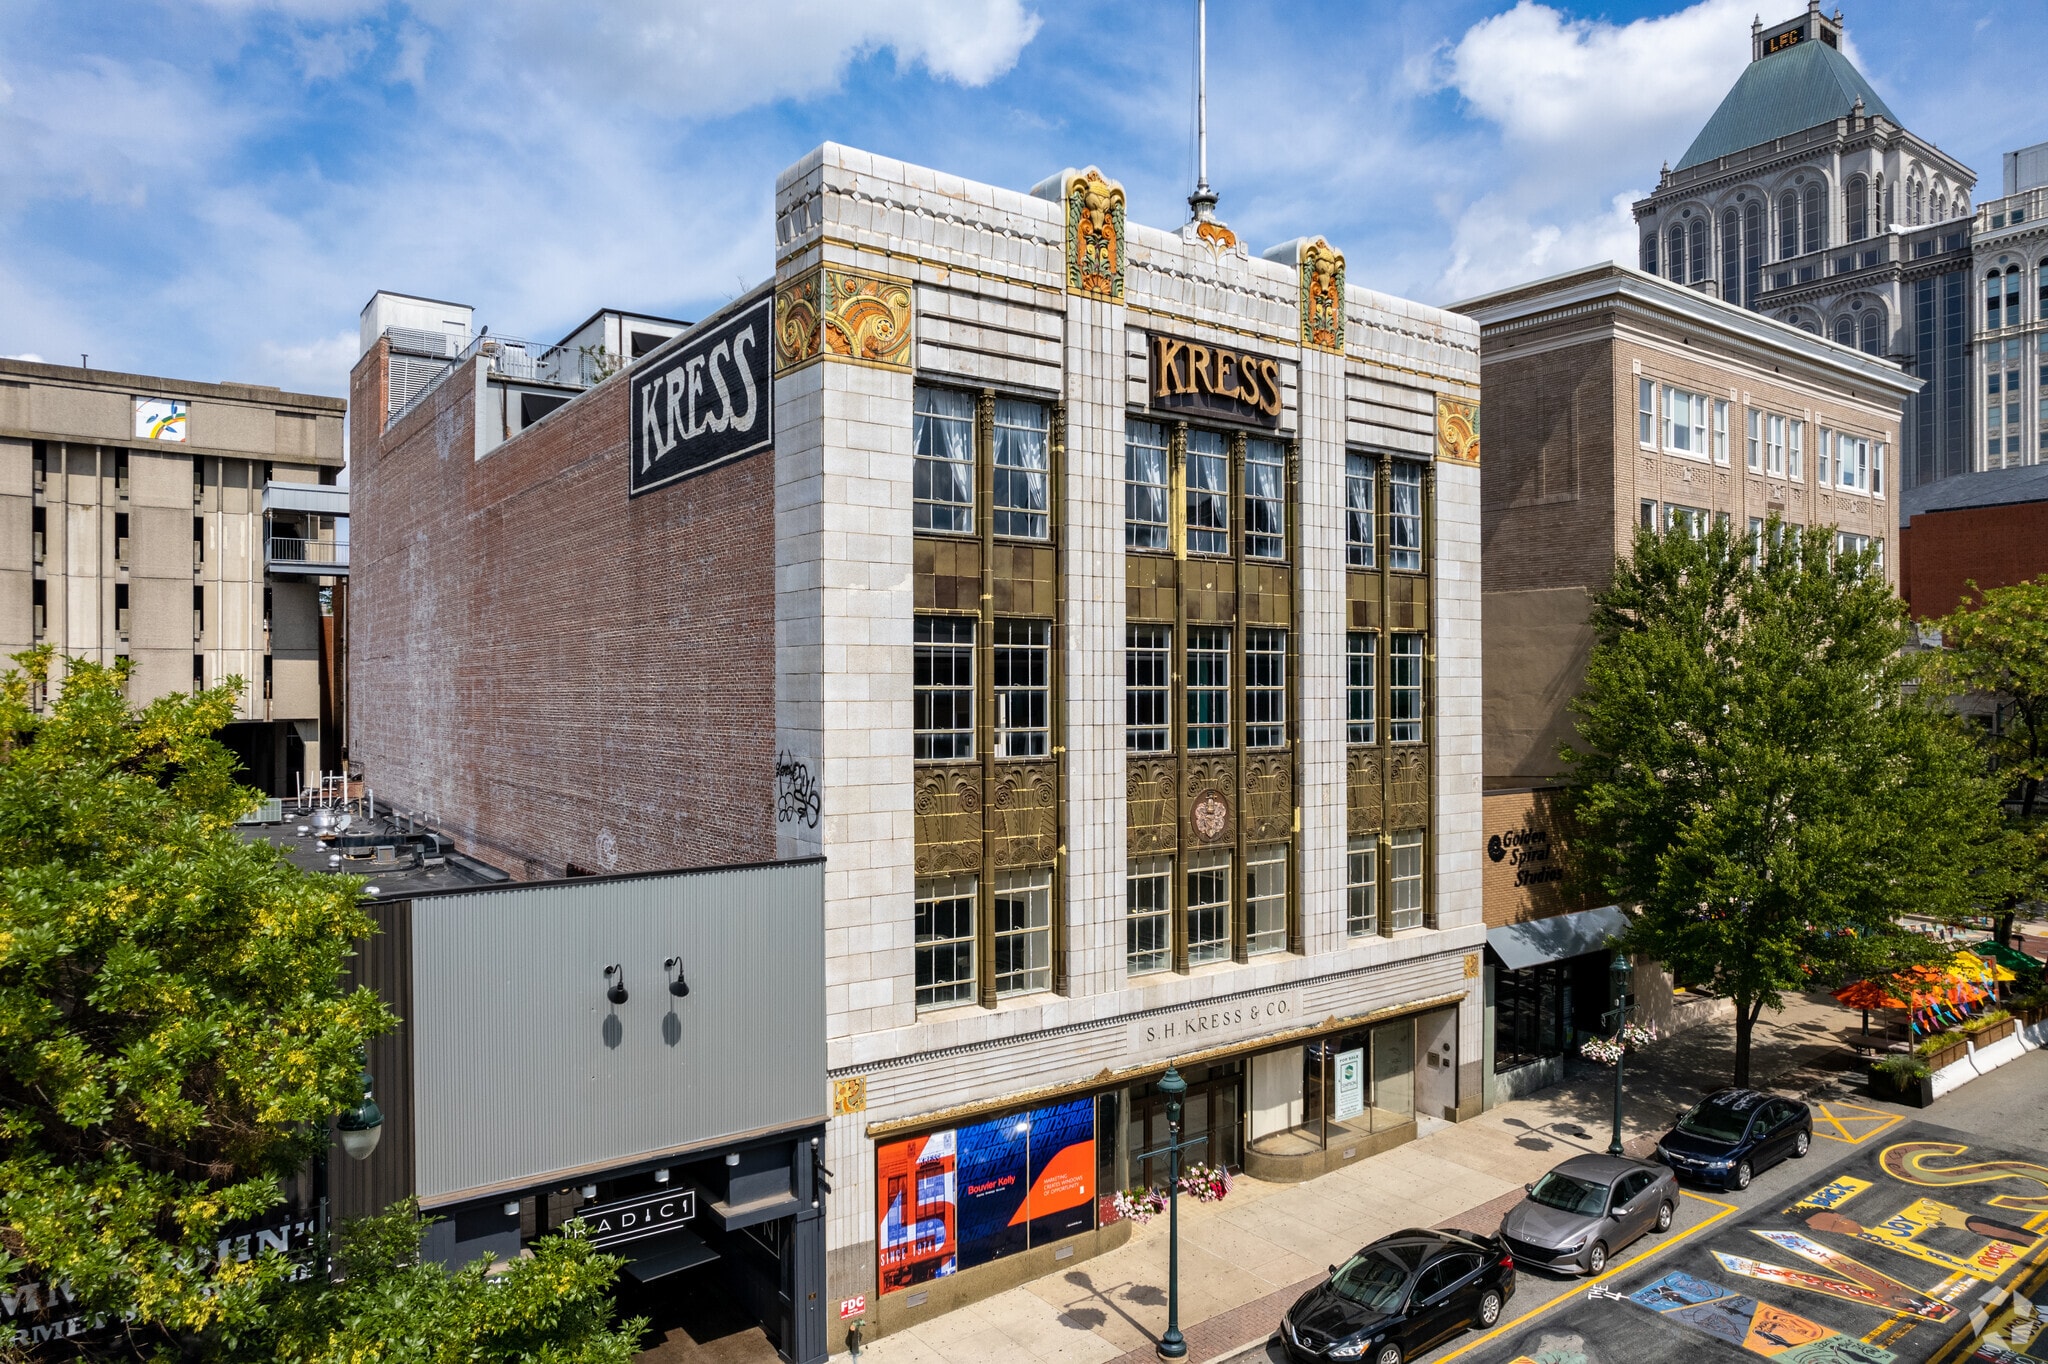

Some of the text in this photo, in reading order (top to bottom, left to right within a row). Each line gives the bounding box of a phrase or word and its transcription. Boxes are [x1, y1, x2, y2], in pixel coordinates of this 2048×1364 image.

[1156, 335, 1281, 416] KRESS
[641, 323, 757, 475] KRESS
[1503, 828, 1547, 848] Golden
[1509, 844, 1551, 870] Spiral
[1514, 867, 1563, 888] Studios
[1185, 1009, 1242, 1035] KRESS
[1250, 1005, 1260, 1020] &
[967, 1180, 997, 1195] Bouvier
[997, 1174, 1015, 1187] Kelly
[880, 1241, 933, 1267] SINCE 1974
[841, 1295, 864, 1312] FDC
